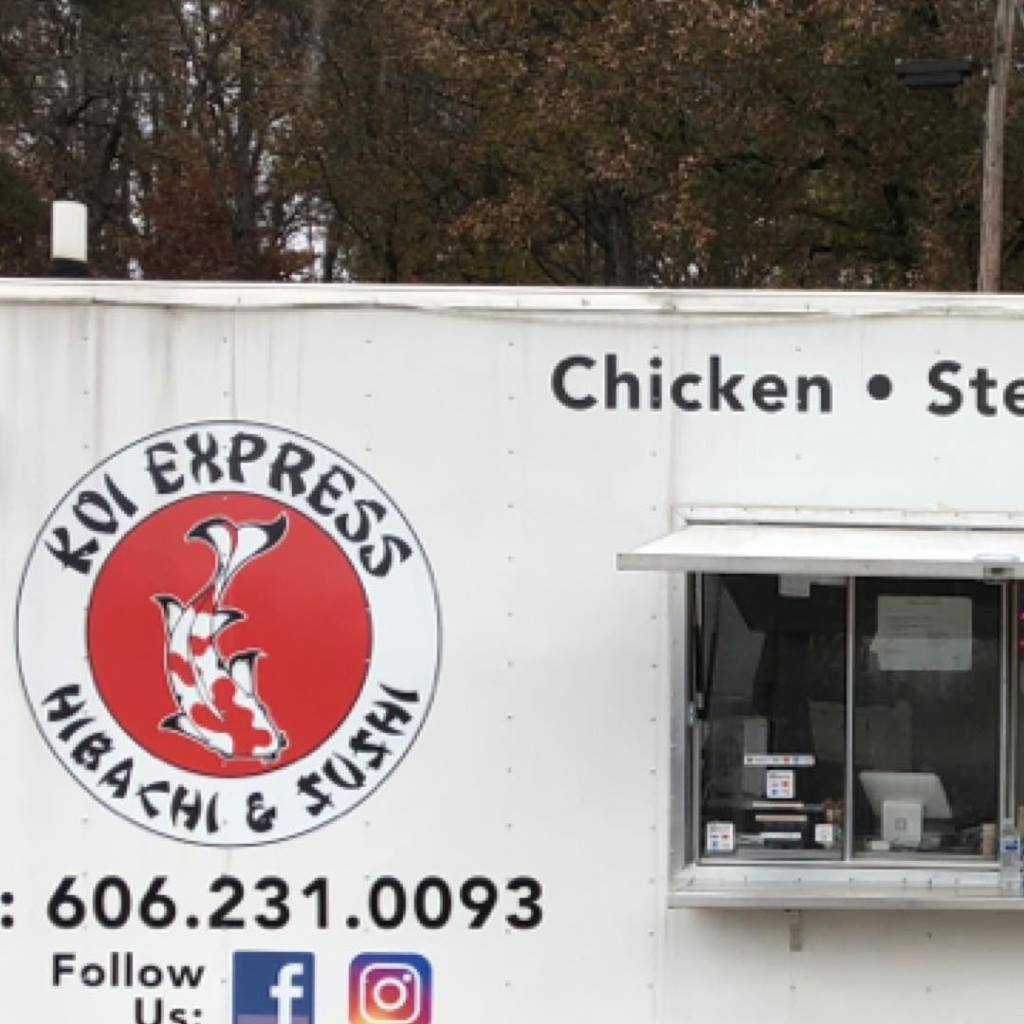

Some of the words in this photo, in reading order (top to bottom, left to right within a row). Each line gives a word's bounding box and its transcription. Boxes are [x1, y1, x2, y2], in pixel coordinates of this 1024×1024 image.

[552, 353, 831, 413] Chicken
[44, 473, 138, 576] KOI
[144, 431, 413, 578] EXPRESS
[41, 683, 221, 834] HIBACHI
[245, 791, 279, 832] &
[295, 683, 421, 818] SUSHI
[47, 875, 543, 930] 606.231.0093
[52, 951, 204, 988] Follow
